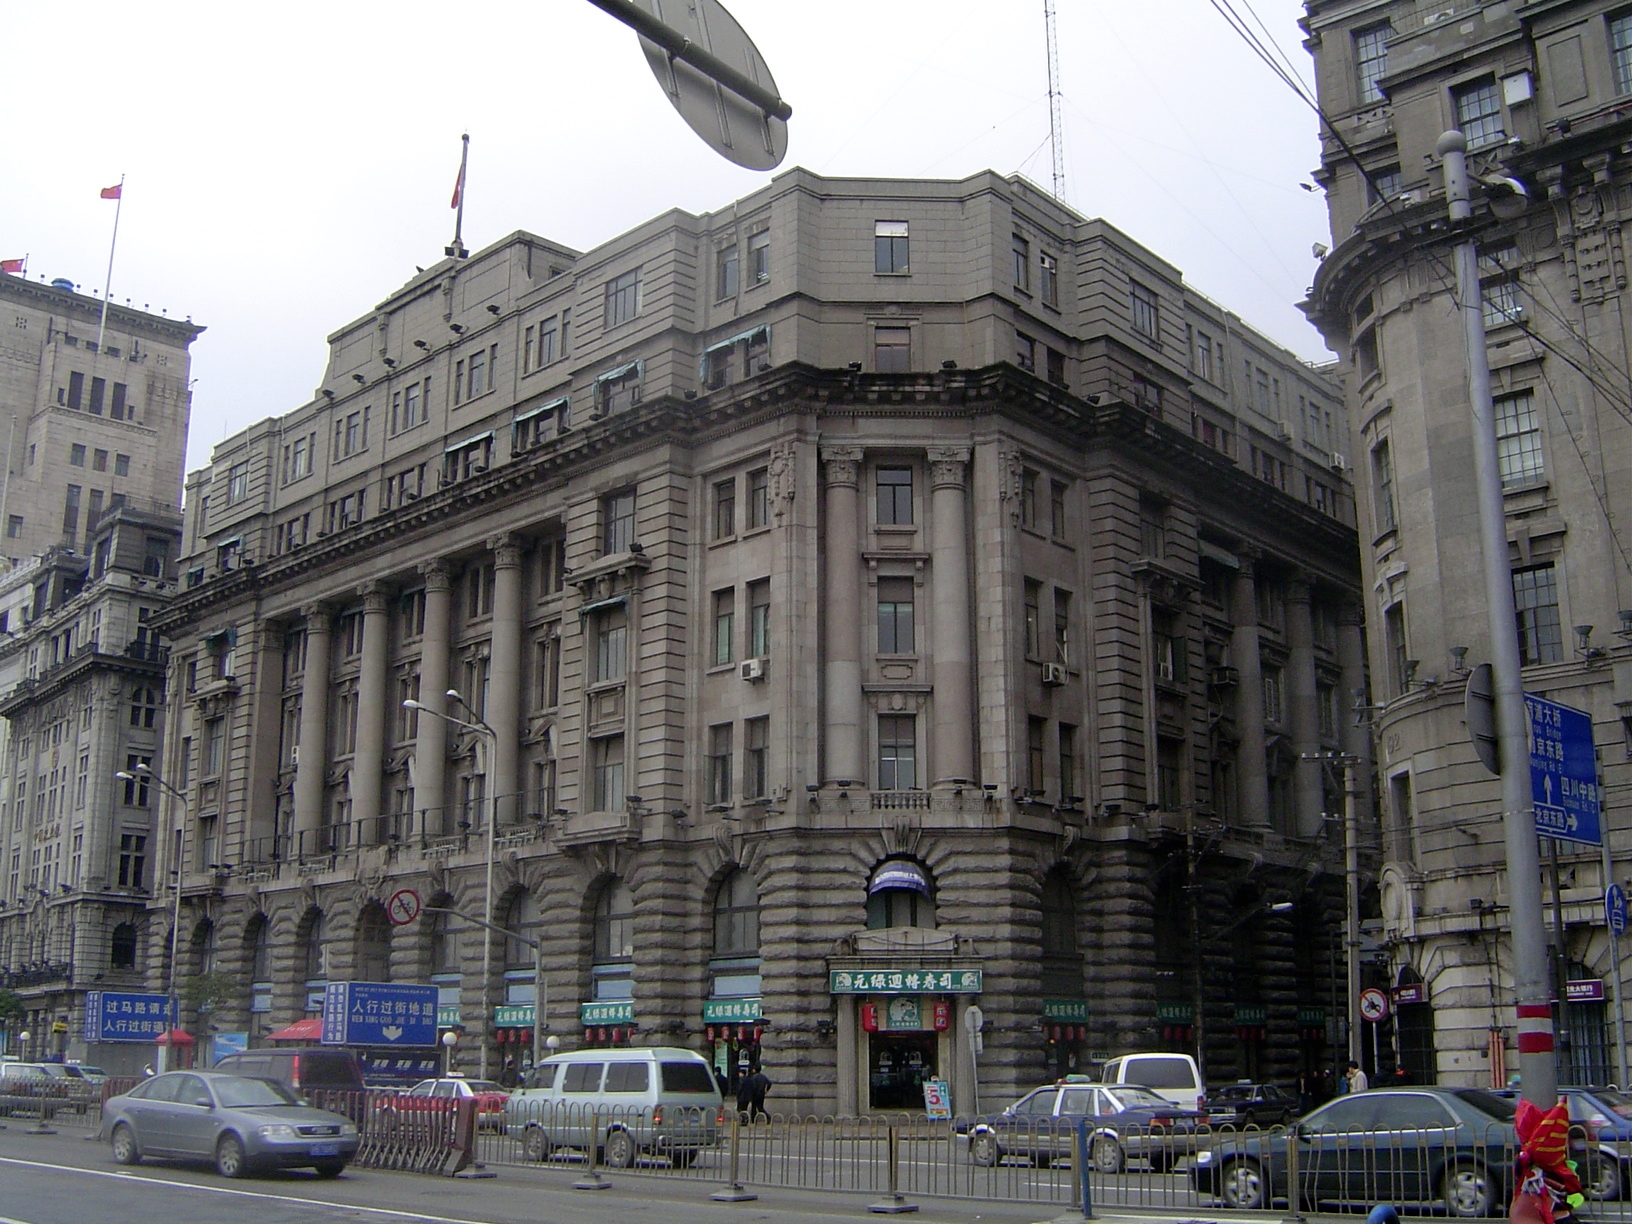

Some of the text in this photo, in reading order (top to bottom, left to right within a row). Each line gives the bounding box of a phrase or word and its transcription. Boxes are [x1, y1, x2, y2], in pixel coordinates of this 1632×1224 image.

[1561, 776, 1596, 802] 四川中路
[352, 999, 434, 1016] 人行过街地道
